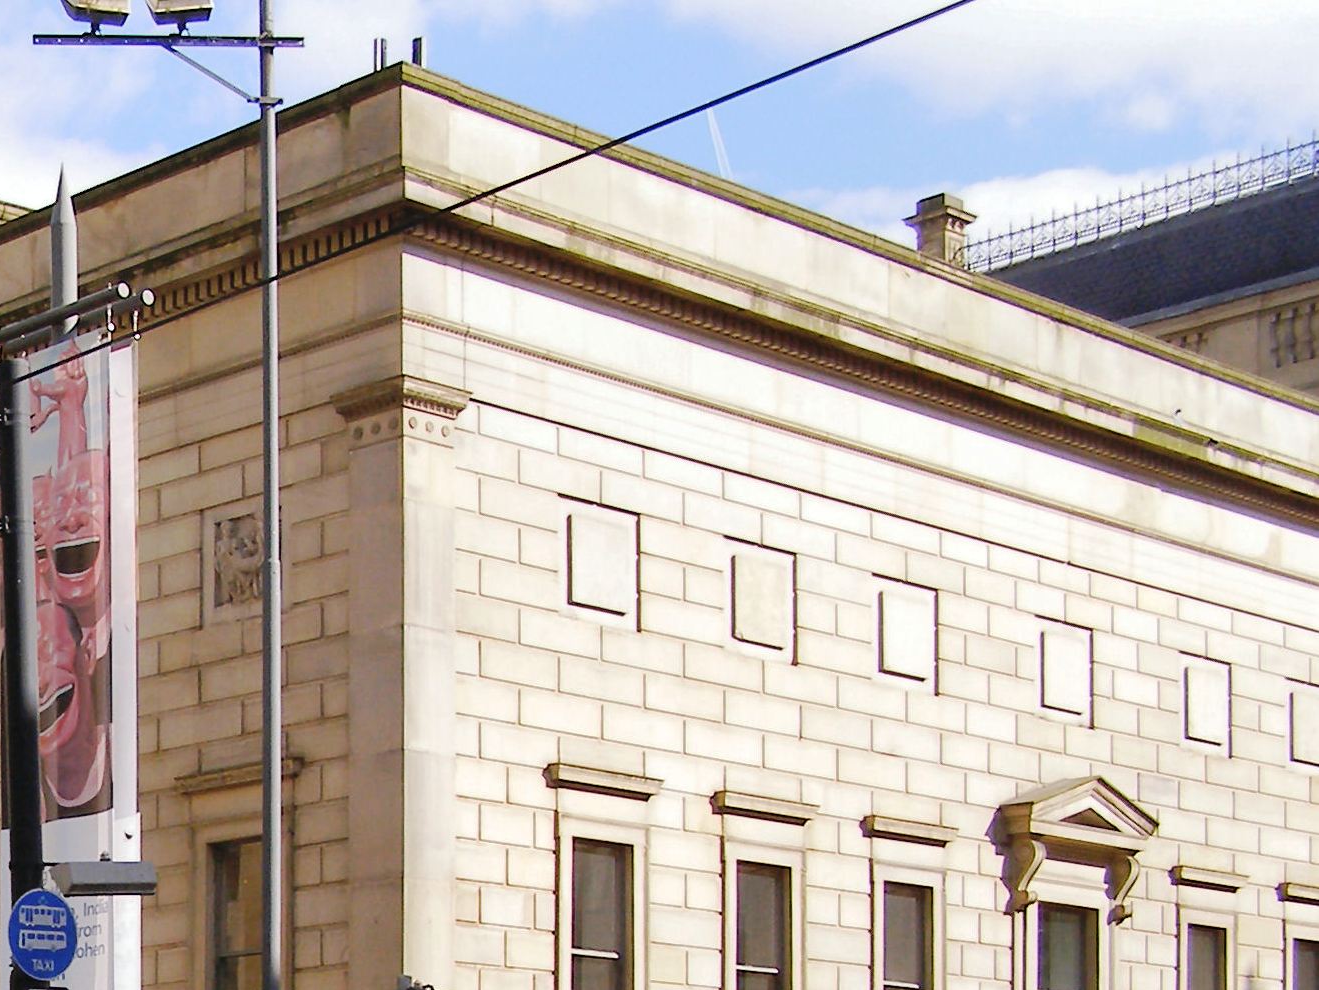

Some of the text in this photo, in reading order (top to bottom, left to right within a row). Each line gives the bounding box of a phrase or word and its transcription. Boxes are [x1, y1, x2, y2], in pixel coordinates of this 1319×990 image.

[78, 924, 101, 937] rom
[76, 942, 105, 958] ohen
[32, 958, 55, 971] TAXI
